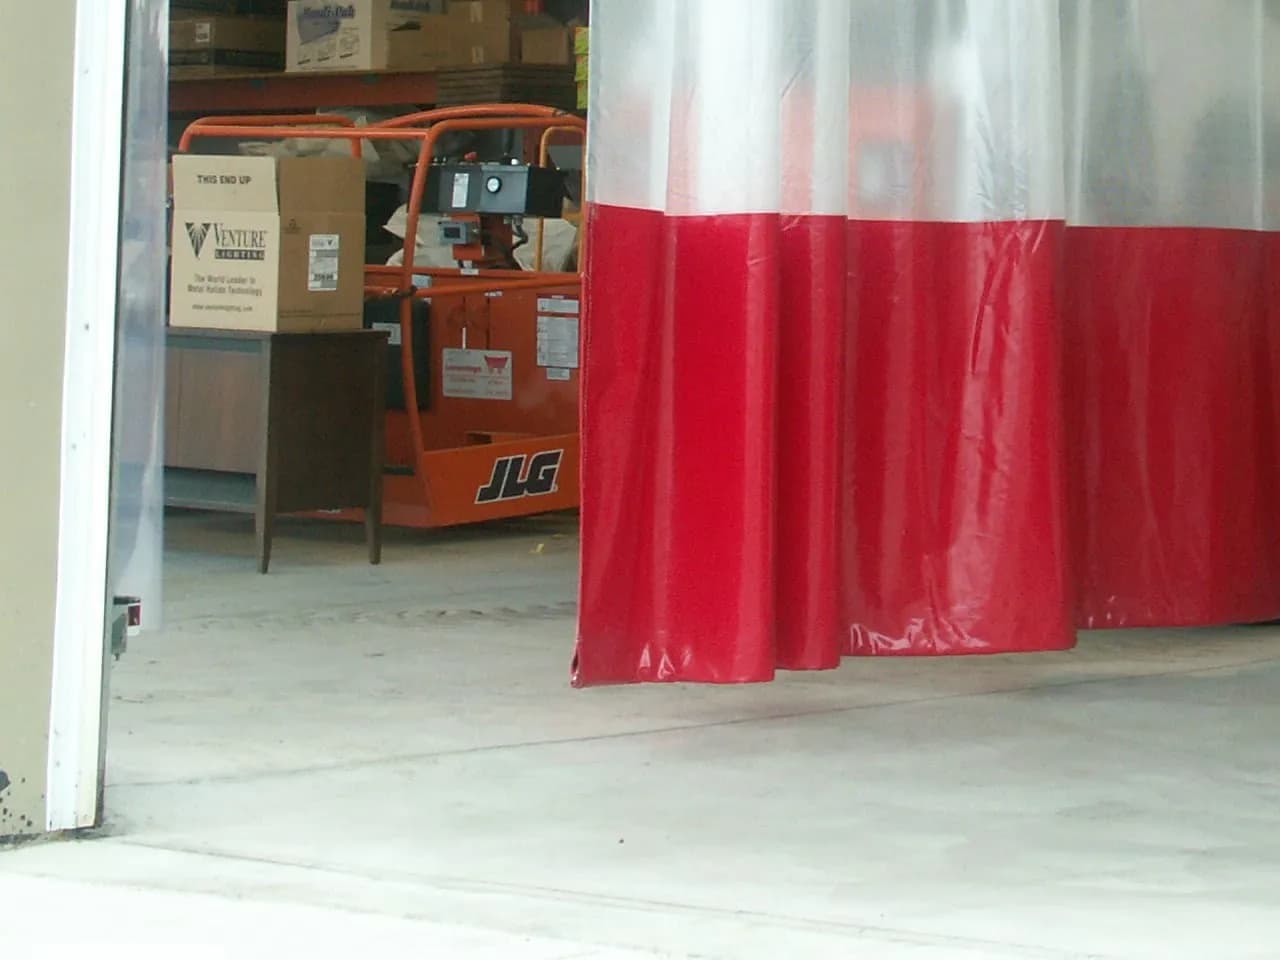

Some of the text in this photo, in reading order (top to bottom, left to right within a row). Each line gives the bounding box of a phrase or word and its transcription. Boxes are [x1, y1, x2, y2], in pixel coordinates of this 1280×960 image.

[197, 175, 252, 184] THIS END UP
[207, 274, 225, 284] World
[226, 275, 247, 285] Leader
[228, 285, 263, 296] Technology
[474, 449, 563, 504] JLG
